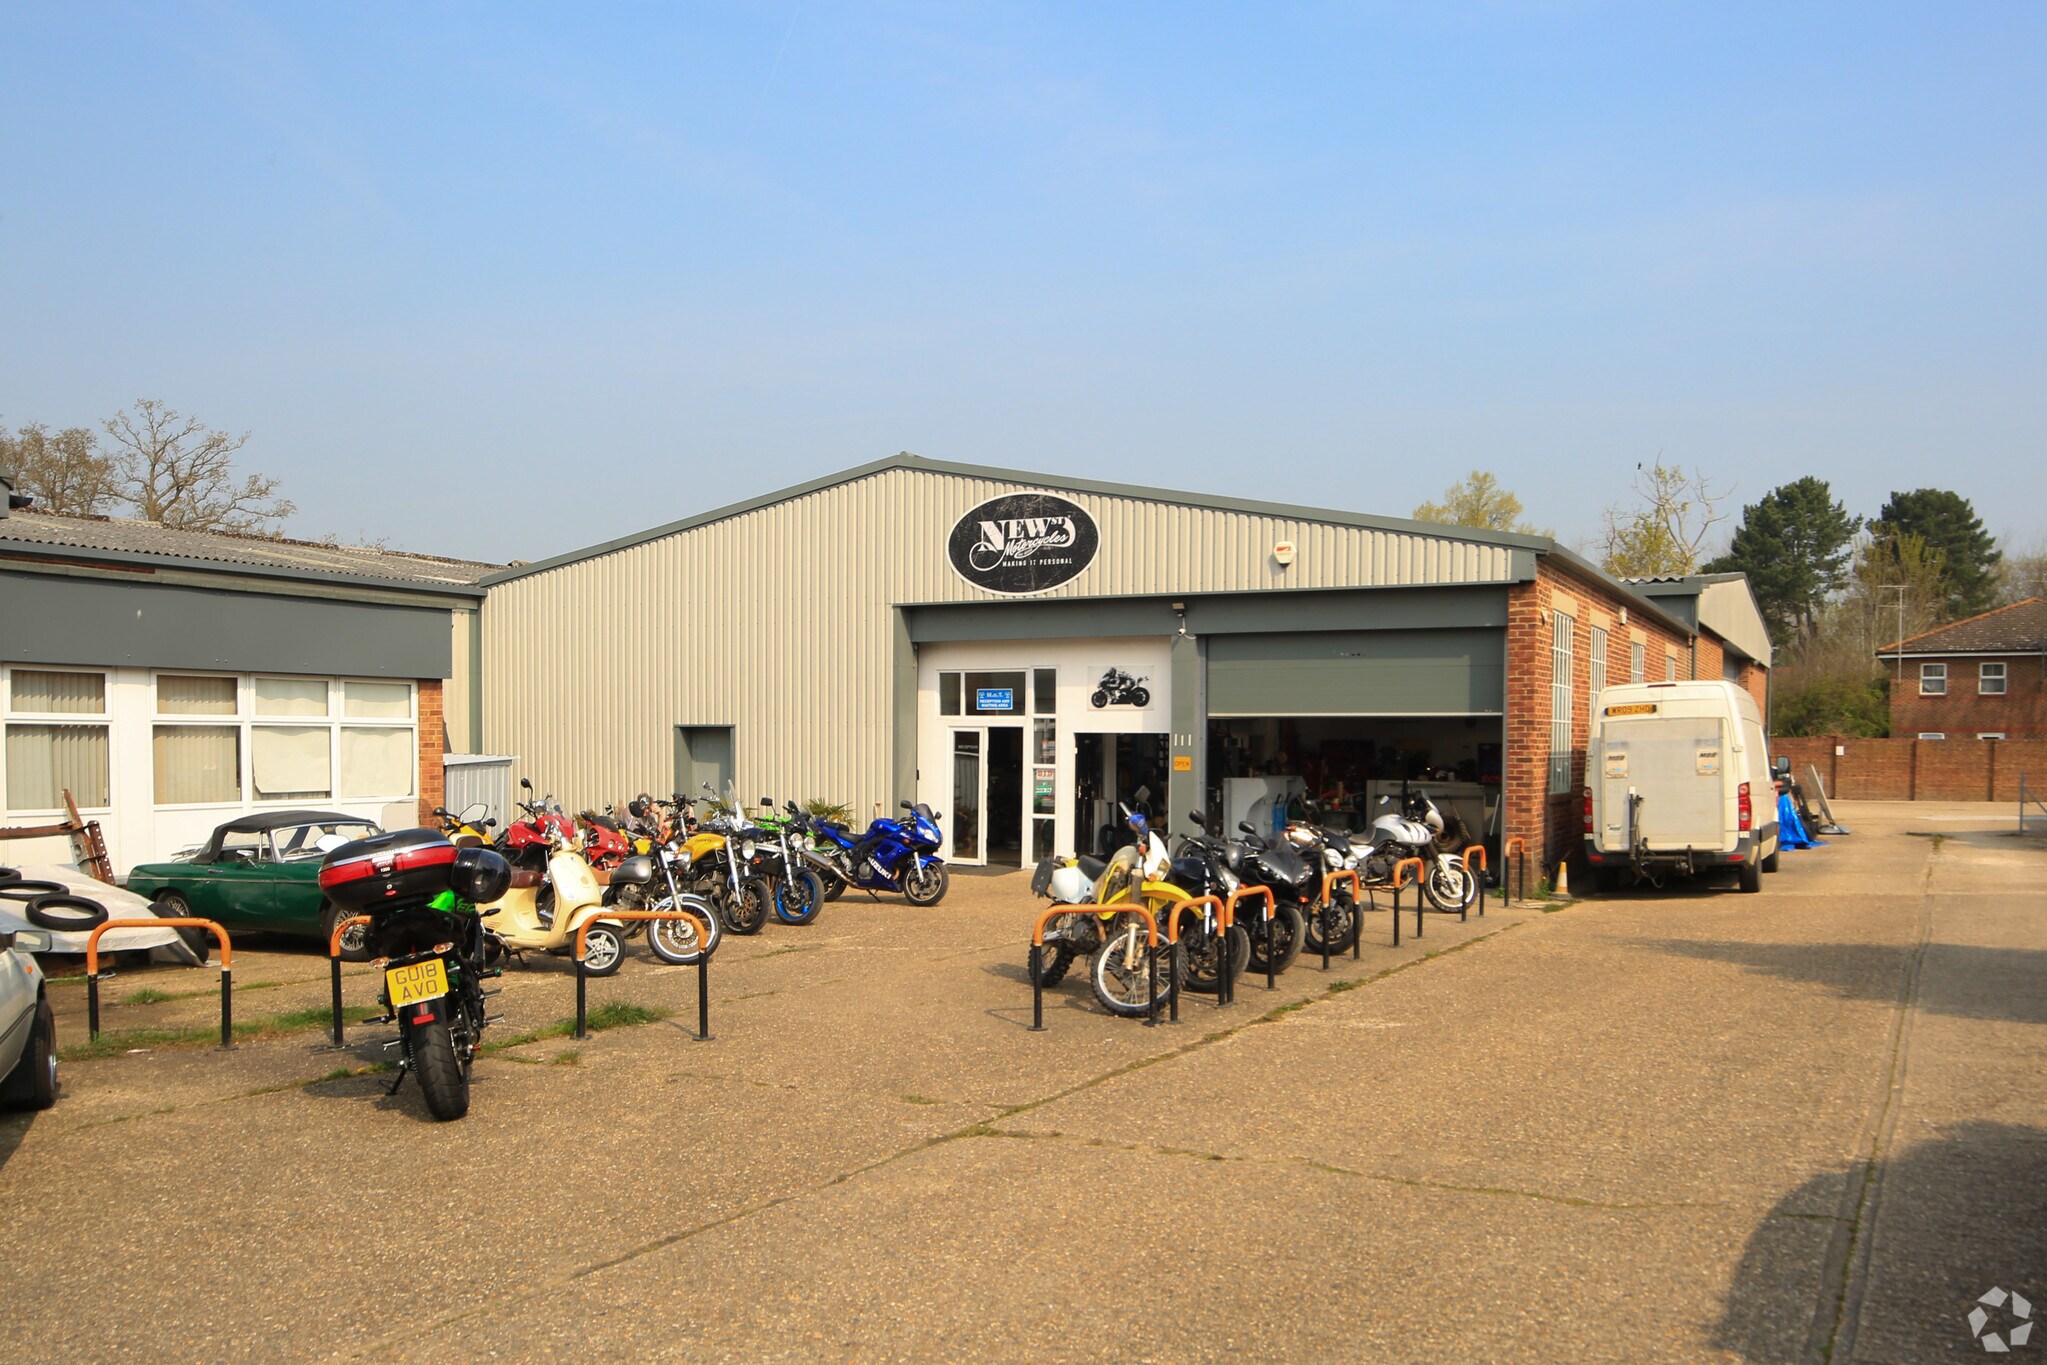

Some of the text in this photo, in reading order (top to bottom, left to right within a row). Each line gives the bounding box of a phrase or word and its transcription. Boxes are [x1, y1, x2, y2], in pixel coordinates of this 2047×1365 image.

[1004, 530, 1069, 559] Motorcycles
[1040, 557, 1073, 565] PERSONAL
[867, 856, 892, 879] SUZUKI
[395, 963, 437, 985] GU18
